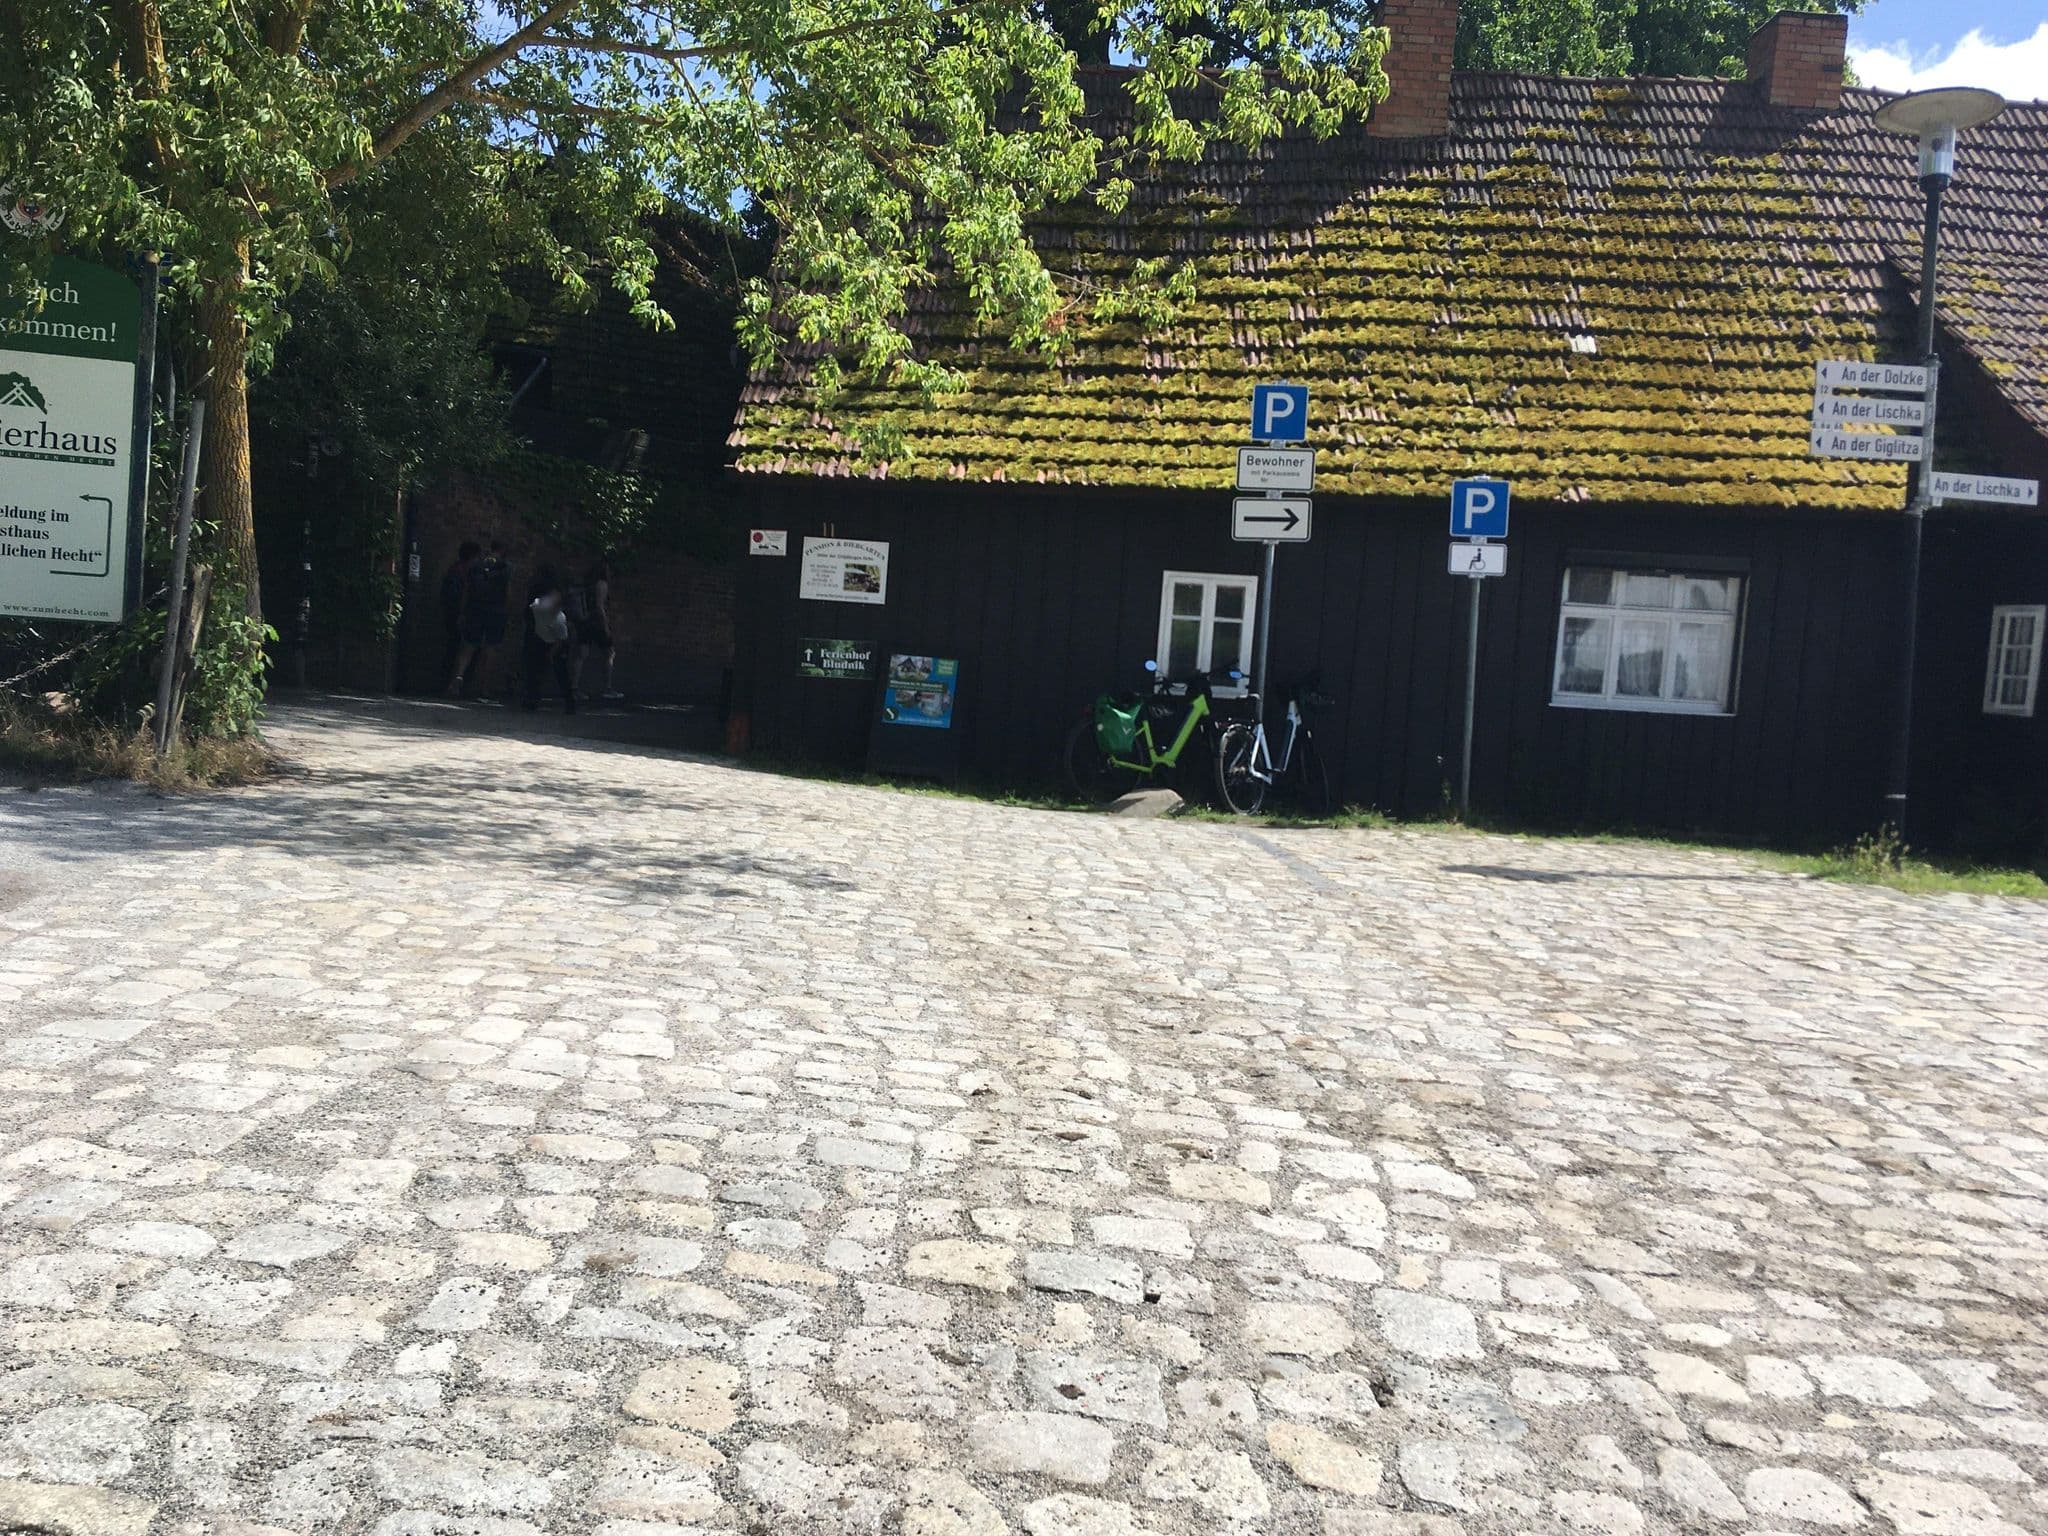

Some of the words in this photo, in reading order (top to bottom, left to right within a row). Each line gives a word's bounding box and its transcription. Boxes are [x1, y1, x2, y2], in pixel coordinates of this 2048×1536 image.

[7, 279, 80, 304] lich
[1842, 366, 1856, 380] An
[1861, 368, 1881, 382] der
[1885, 369, 1924, 385] Dolzke
[1265, 392, 1295, 433] P
[1832, 401, 1847, 416] An
[1852, 403, 1871, 417] der
[1876, 403, 1921, 420] Lischka
[1831, 436, 1846, 450] An
[1851, 438, 1870, 452] der
[1875, 438, 1919, 456] Giglitza
[1246, 455, 1305, 468] Bewohner
[1935, 478, 1948, 491] An
[1953, 481, 1972, 493] der
[1976, 480, 2020, 498] Lischka
[51, 509, 69, 522] im
[1464, 488, 1495, 528] P
[3, 604, 110, 618] www.zumhecht.com
[820, 648, 871, 660] Ferienhof
